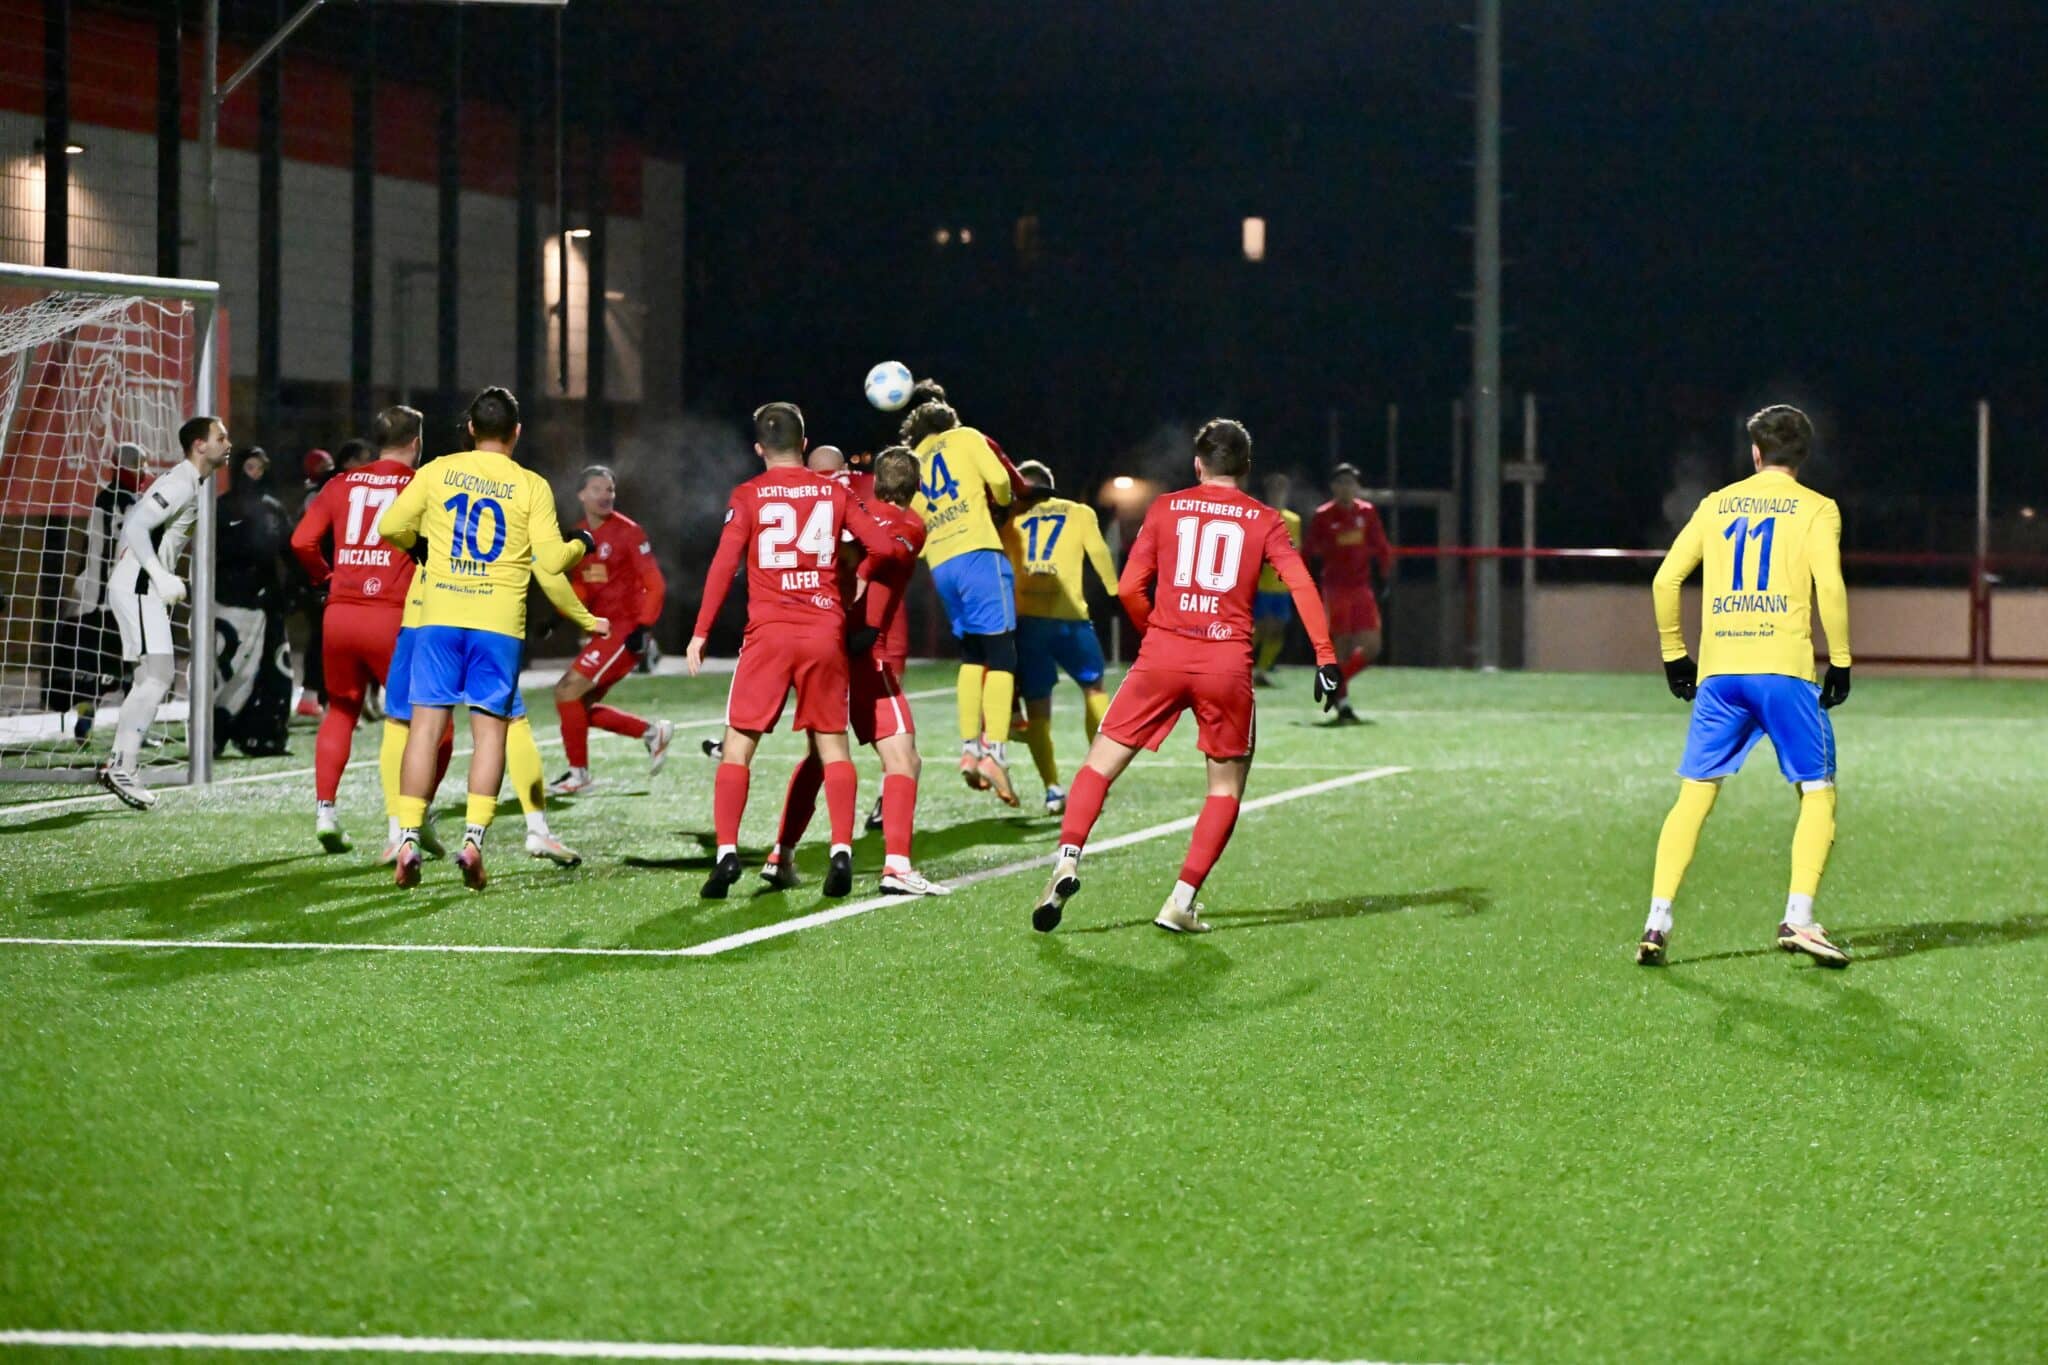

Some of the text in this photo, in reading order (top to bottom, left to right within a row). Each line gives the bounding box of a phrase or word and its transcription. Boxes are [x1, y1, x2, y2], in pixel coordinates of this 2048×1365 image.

[443, 469, 516, 499] LUCKENWALDE
[757, 485, 832, 498] LICHTENBERG 47
[345, 486, 398, 546] 17
[1170, 499, 1260, 520] LICHTENBERG 47
[1718, 496, 1799, 514] LUCKENWALDE
[443, 492, 506, 563] 10
[758, 500, 835, 569] 24
[1021, 514, 1066, 562] 17
[450, 557, 490, 577] WILL
[1173, 516, 1245, 593] 10
[1723, 516, 1776, 591] 11
[781, 571, 820, 591] ALFER
[1179, 592, 1219, 614] GAWE
